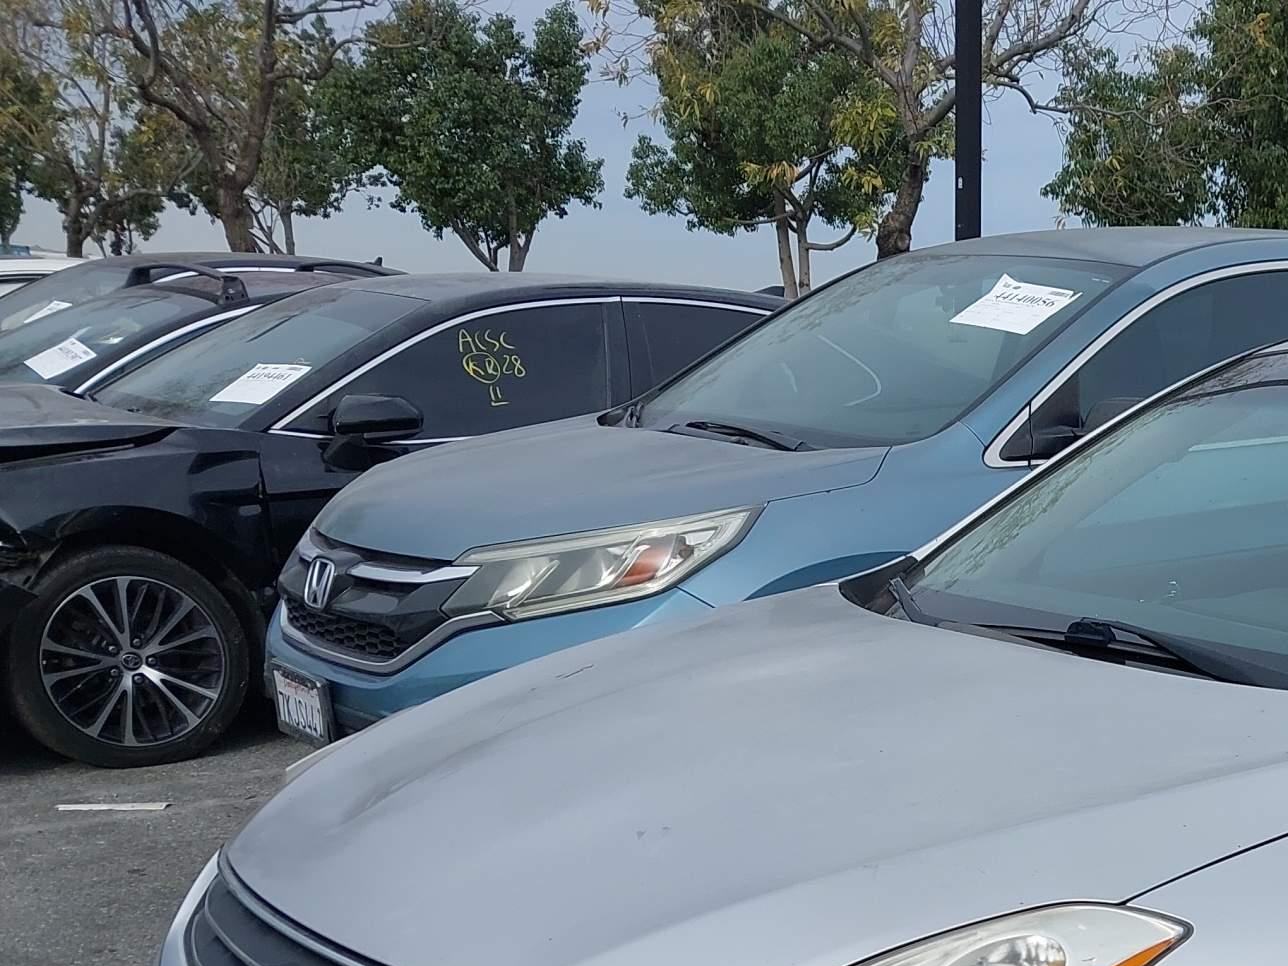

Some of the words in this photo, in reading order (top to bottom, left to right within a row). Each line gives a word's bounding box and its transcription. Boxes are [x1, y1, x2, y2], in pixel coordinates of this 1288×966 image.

[993, 291, 1055, 308] 44140056
[503, 354, 526, 377] 28
[278, 690, 324, 738] 7KJS441
